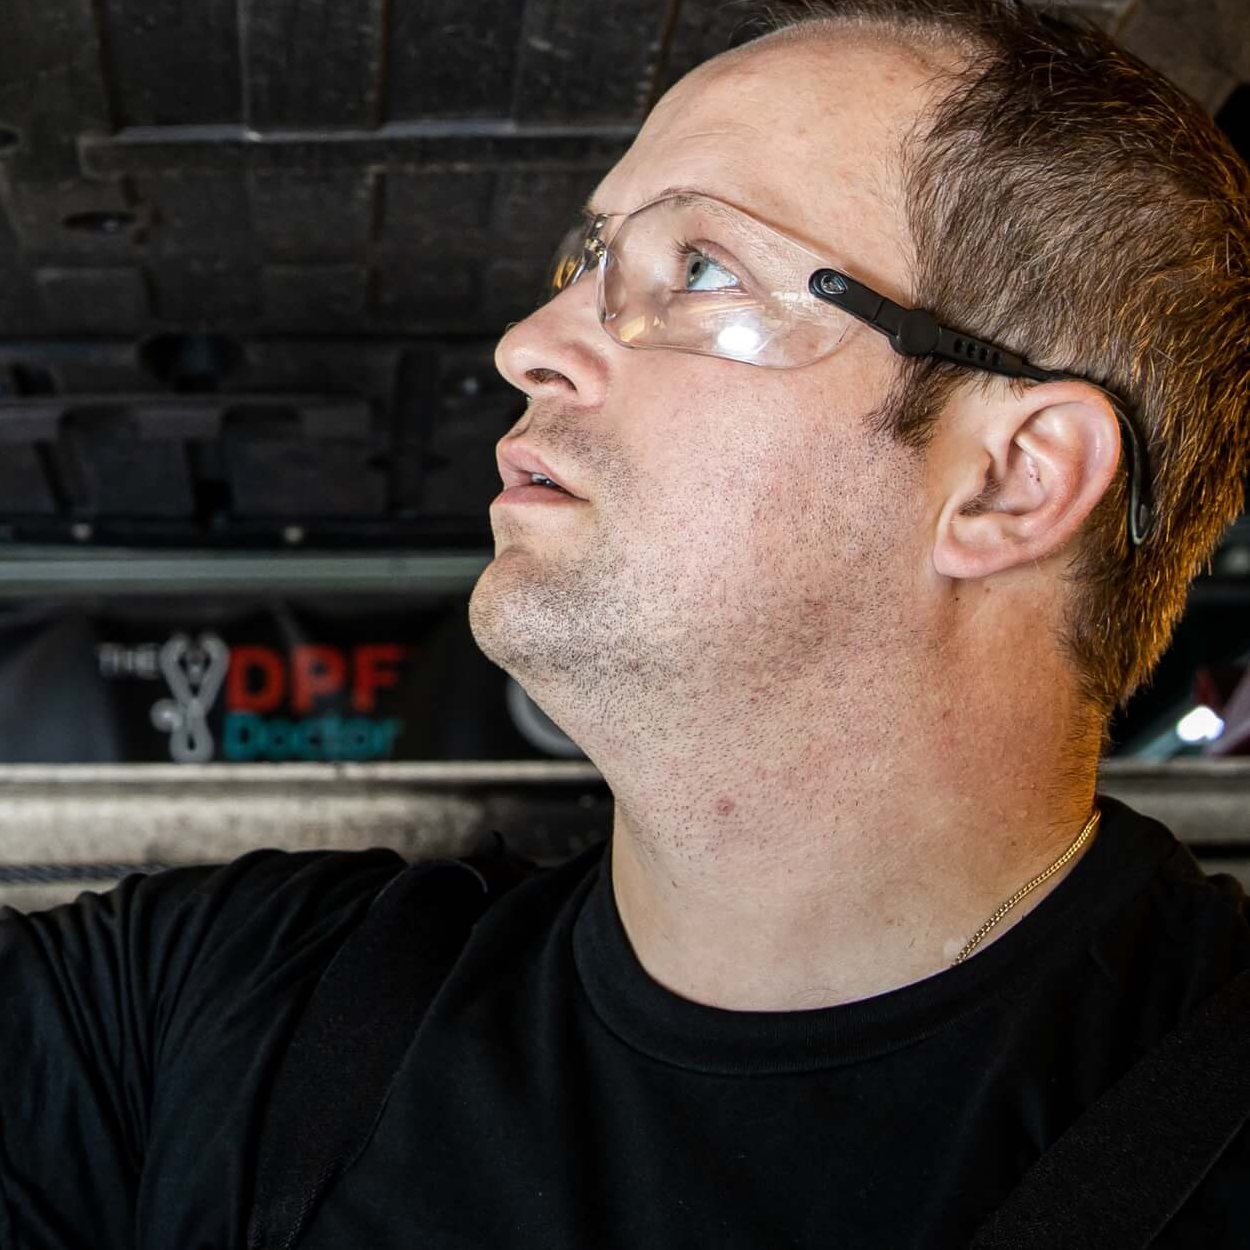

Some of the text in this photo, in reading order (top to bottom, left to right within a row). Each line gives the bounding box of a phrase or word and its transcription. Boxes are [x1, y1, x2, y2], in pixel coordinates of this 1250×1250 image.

[96, 642, 404, 713] THE DPF
[223, 713, 403, 760] Doctor
